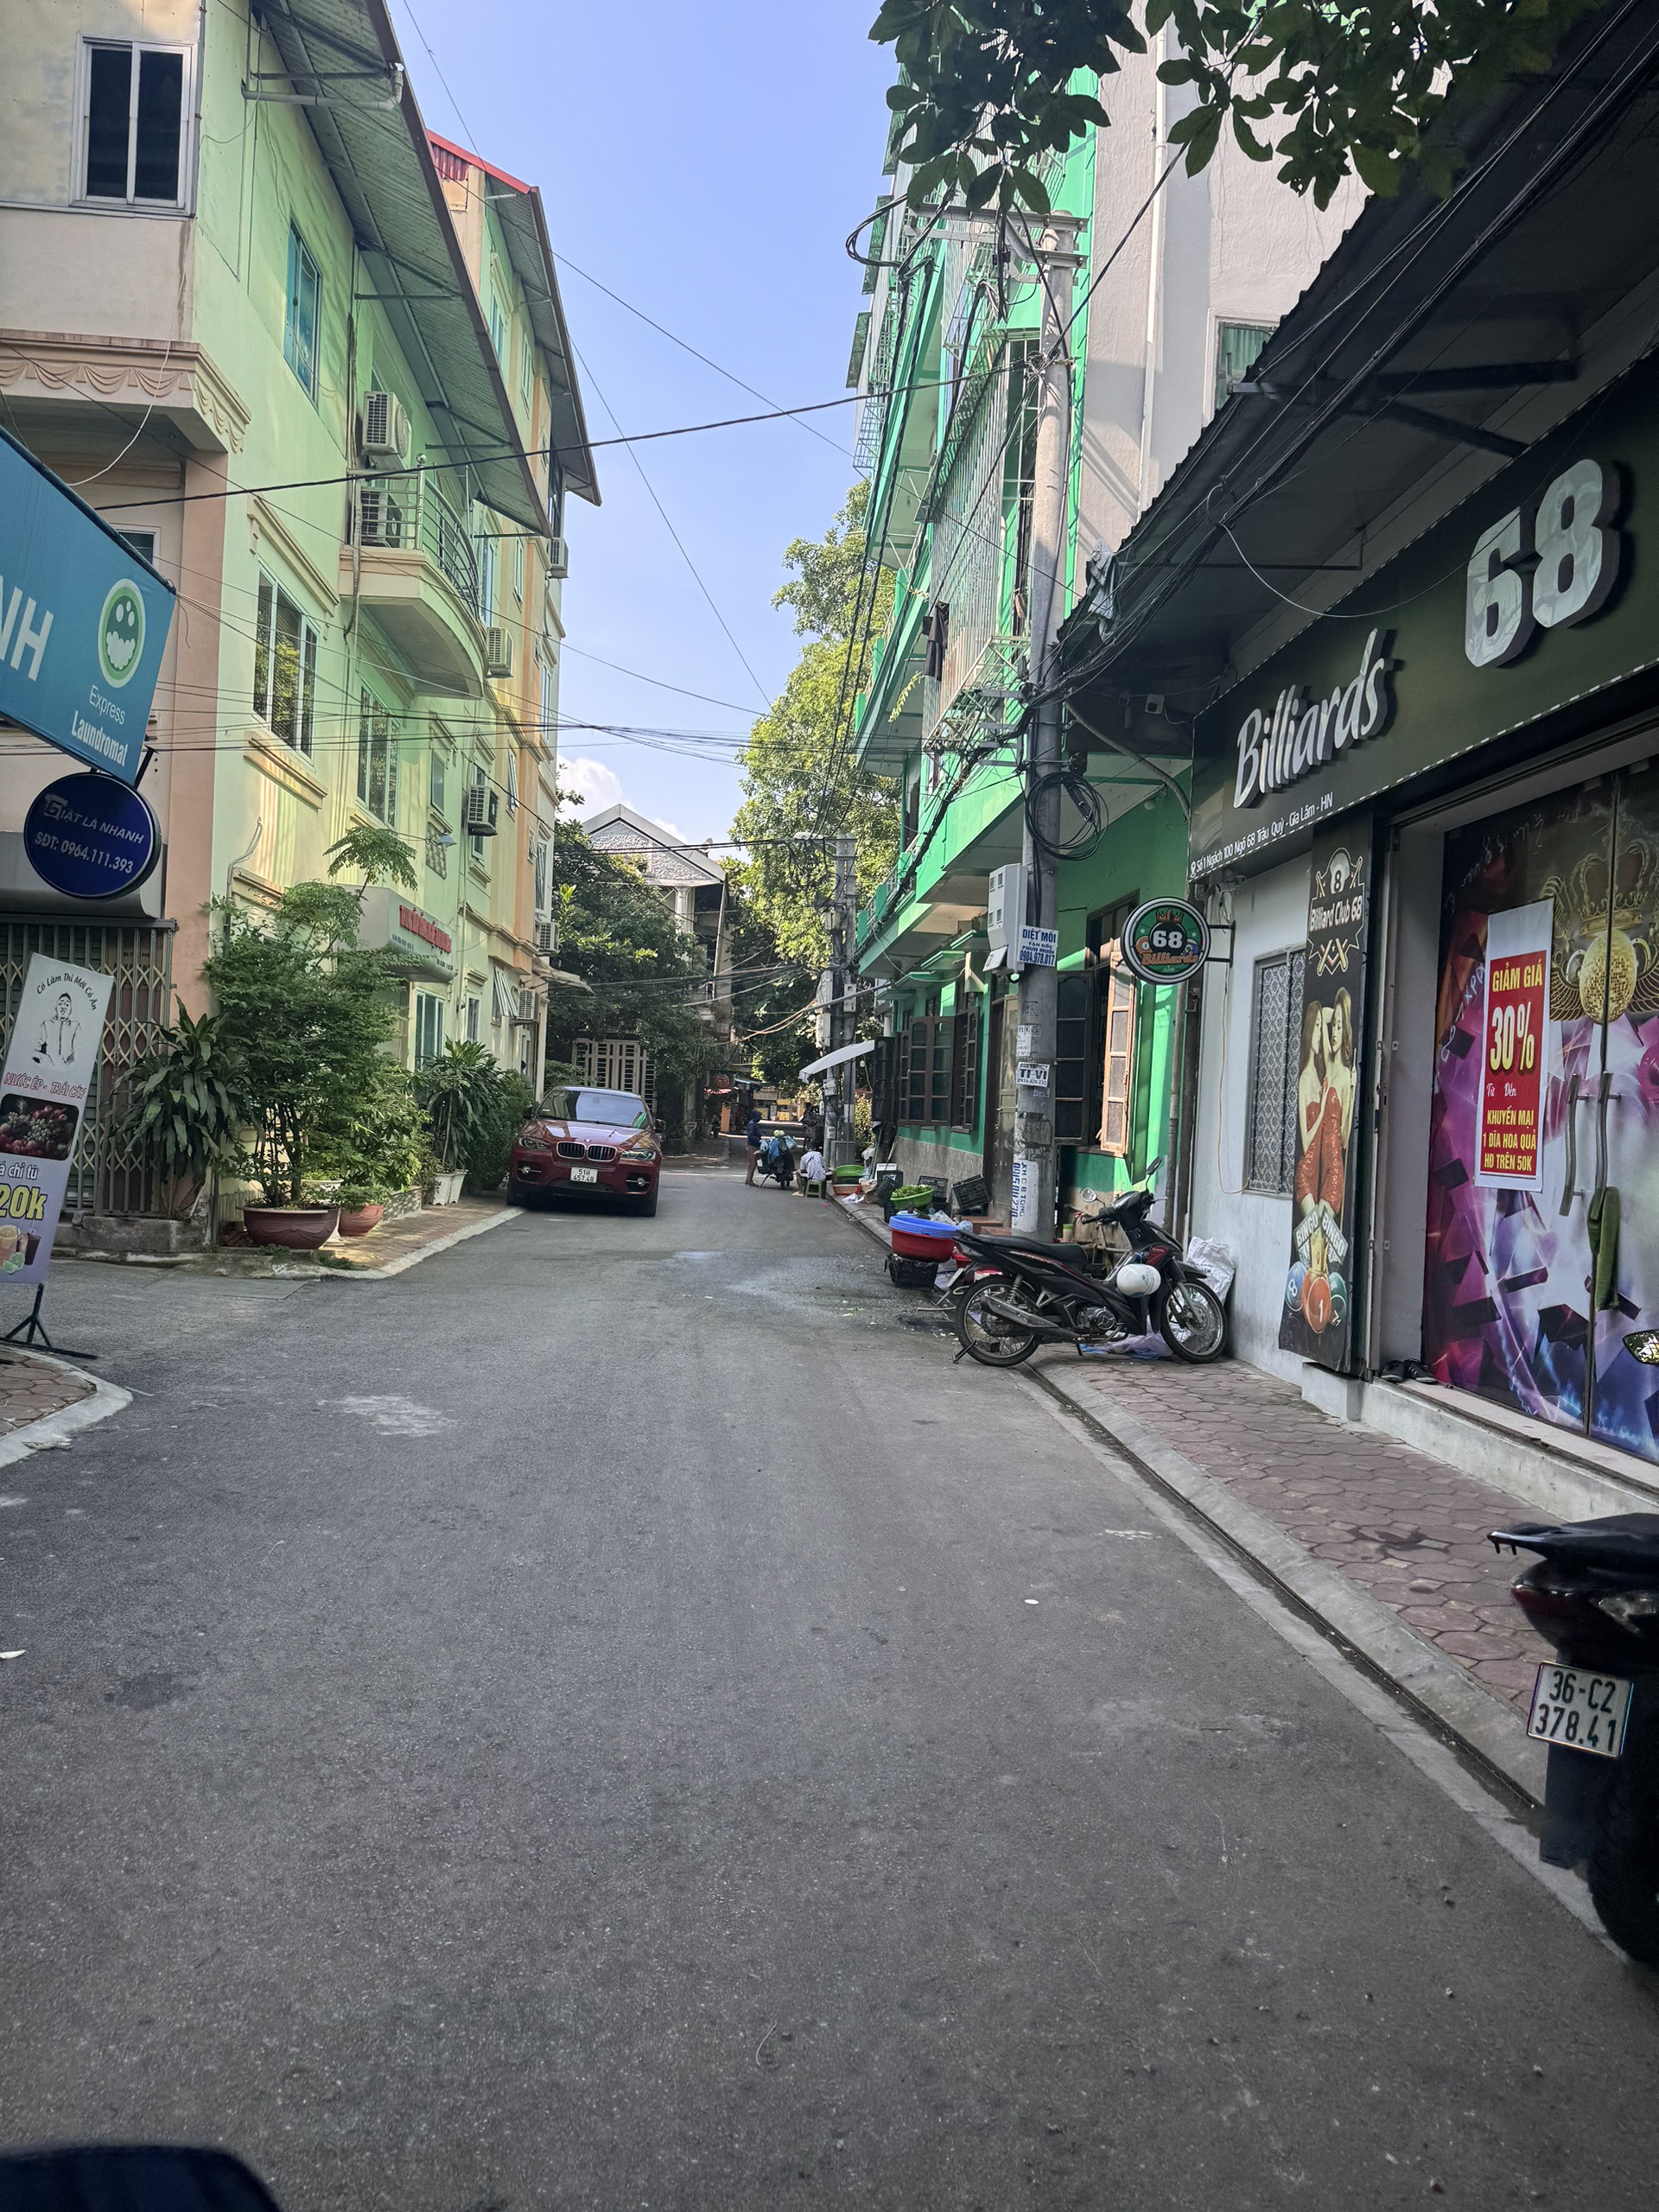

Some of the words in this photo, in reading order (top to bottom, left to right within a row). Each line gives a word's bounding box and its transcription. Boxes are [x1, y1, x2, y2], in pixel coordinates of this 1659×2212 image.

[1233, 627, 1385, 808] Billiards
[1465, 459, 1605, 667] 68
[89, 684, 125, 725] Express
[71, 710, 129, 767] Laundromat
[99, 822, 144, 844] NHANH
[1224, 843, 1233, 859] 100
[1247, 832, 1255, 848] 68
[1300, 804, 1315, 821] Lâm
[1320, 791, 1333, 811] HN
[60, 840, 134, 874] 0964.111.393
[1333, 869, 1342, 892] 8
[1309, 903, 1335, 931] Billiard
[1335, 899, 1351, 925] Club
[1351, 895, 1363, 922] 68
[1022, 928, 1039, 941] DIỆT
[1153, 931, 1183, 949] 68
[1141, 949, 1198, 966] Billiards
[36, 983, 46, 995] Có
[47, 975, 61, 987] Làm
[85, 987, 93, 998] Có
[1492, 962, 1520, 993] GIẢM
[1522, 958, 1542, 988] GIÁ
[1490, 1001, 1535, 1071] 30%
[4, 1072, 31, 1089] NƯỚC
[30, 1076, 43, 1090] ÉP
[50, 1081, 69, 1095] TRÁI
[1487, 1105, 1516, 1125] KHUYẾN
[1518, 1109, 1534, 1128] MẠI
[1488, 1130, 1501, 1147] ĐĨA
[1503, 1133, 1518, 1149] HOA
[1520, 1128, 1536, 1151] QUẢ
[8, 1161, 25, 1178] chỉ
[1484, 1153, 1494, 1168] HĐ
[1496, 1151, 1515, 1170] TRÊN
[1517, 1155, 1532, 1172] 50K
[0, 1183, 48, 1221] 20k
[1296, 1211, 1319, 1247] BINGO
[1322, 1212, 1344, 1256] BINGO
[1549, 1670, 1616, 1713] 36-C2
[1535, 1703, 1617, 1751] 378.41
